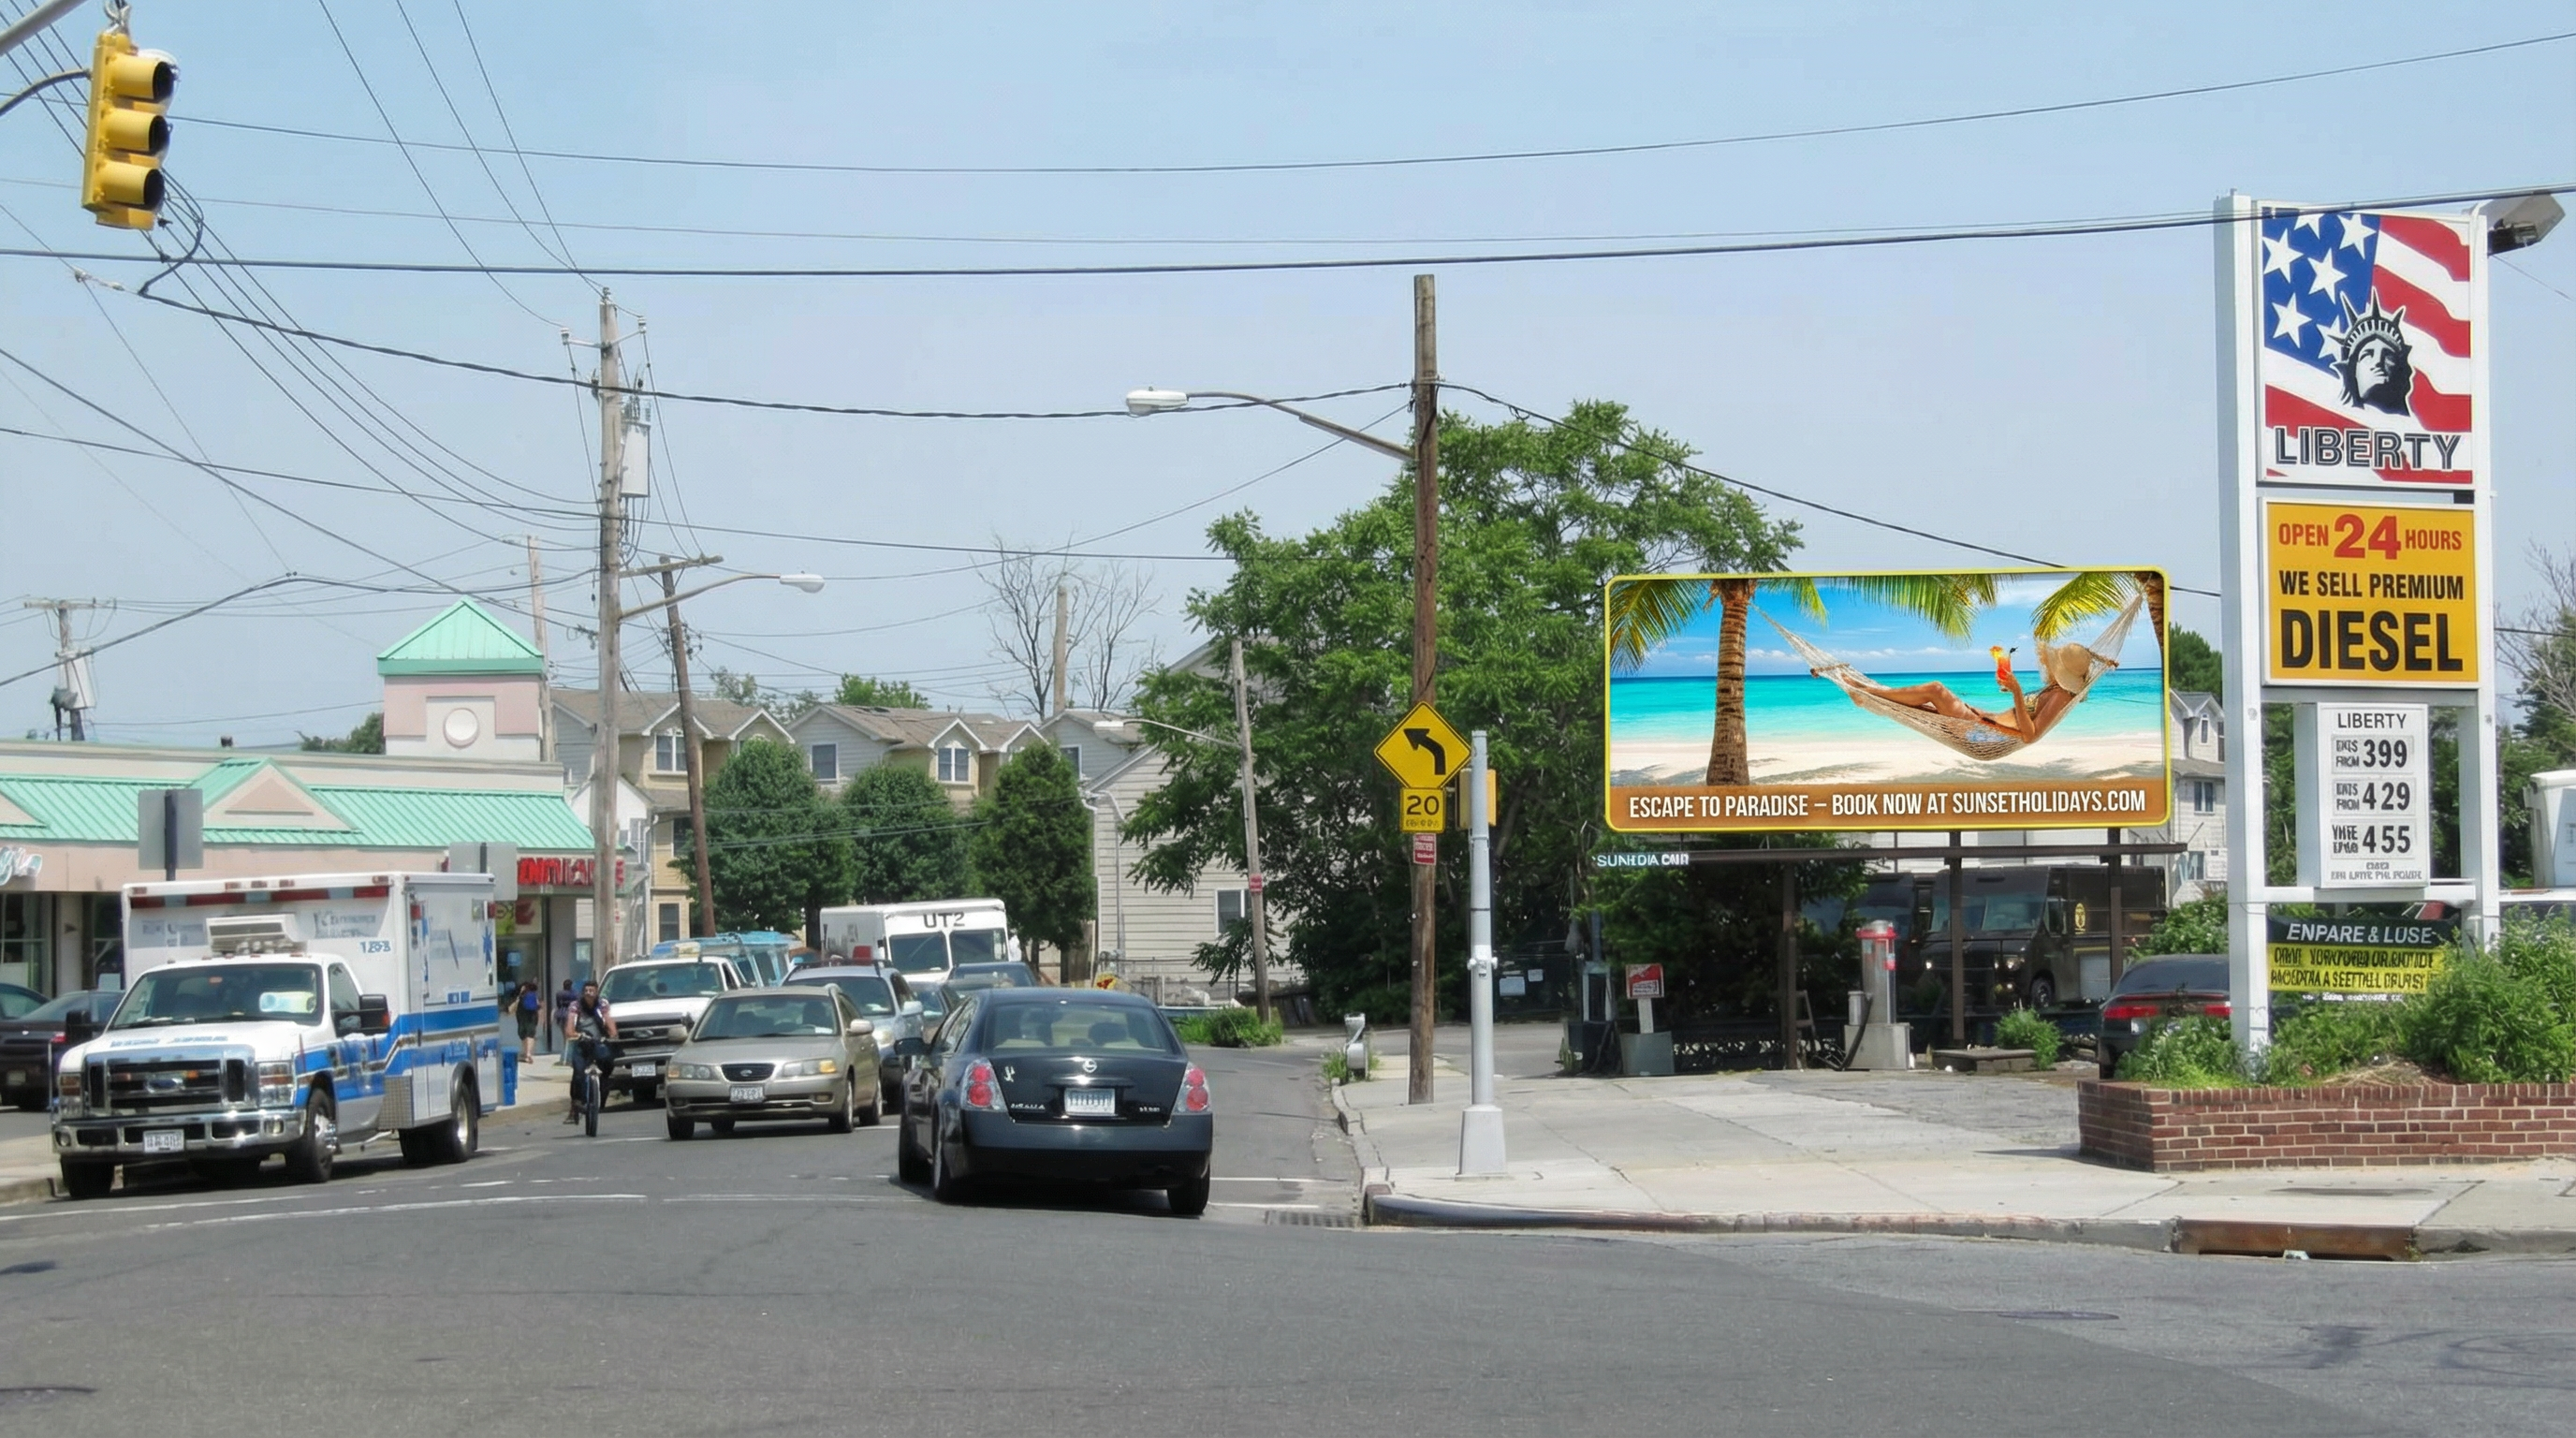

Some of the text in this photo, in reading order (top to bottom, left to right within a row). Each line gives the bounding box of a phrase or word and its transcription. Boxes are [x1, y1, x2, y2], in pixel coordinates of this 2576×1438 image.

[2274, 427, 2462, 470] LIBERTY
[2278, 513, 2462, 560] OPEN 24 HOURS
[2279, 570, 2464, 600] WE SELL PREMIUM
[2280, 609, 2464, 672] DIESEL
[2337, 712, 2407, 729] LIBERTY
[2363, 739, 2408, 768] 399
[1406, 795, 1440, 815] 20
[1630, 796, 1694, 818] ESCAPE
[1699, 796, 1720, 817] TO
[1725, 795, 1808, 817] PARADISE
[1832, 794, 1879, 815] BOOK
[1882, 793, 1922, 814] NOW
[1926, 793, 1948, 814] AT
[1953, 790, 2145, 814] SUNSETHOLIDAYS.COM
[2363, 782, 2410, 811] 429
[2362, 826, 2411, 854] 455
[923, 911, 965, 928] UT2
[2368, 926, 2379, 943] &
